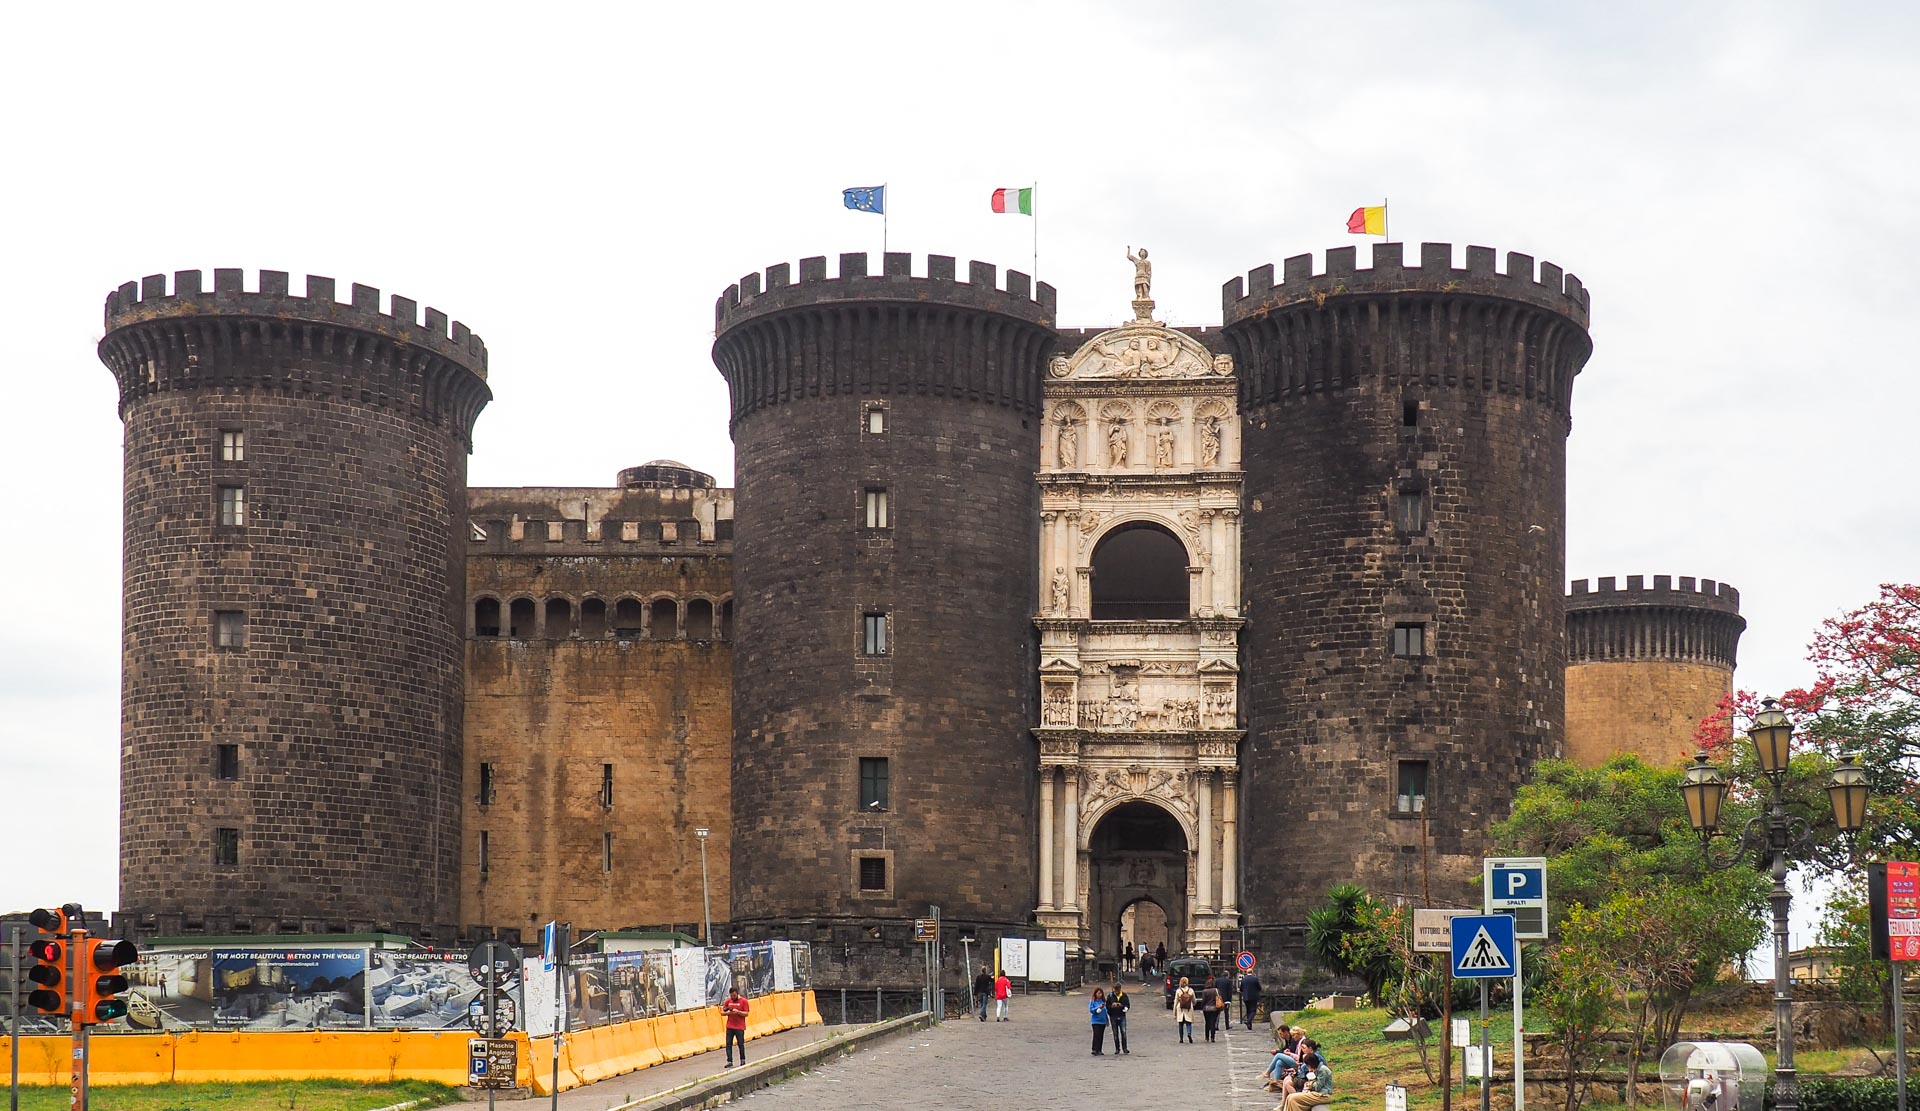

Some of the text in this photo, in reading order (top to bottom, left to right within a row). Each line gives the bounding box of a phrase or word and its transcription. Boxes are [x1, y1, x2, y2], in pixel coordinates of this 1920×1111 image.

[1508, 872, 1527, 895] P
[1889, 921, 1911, 934] TERMINAL
[475, 1060, 484, 1072] P
